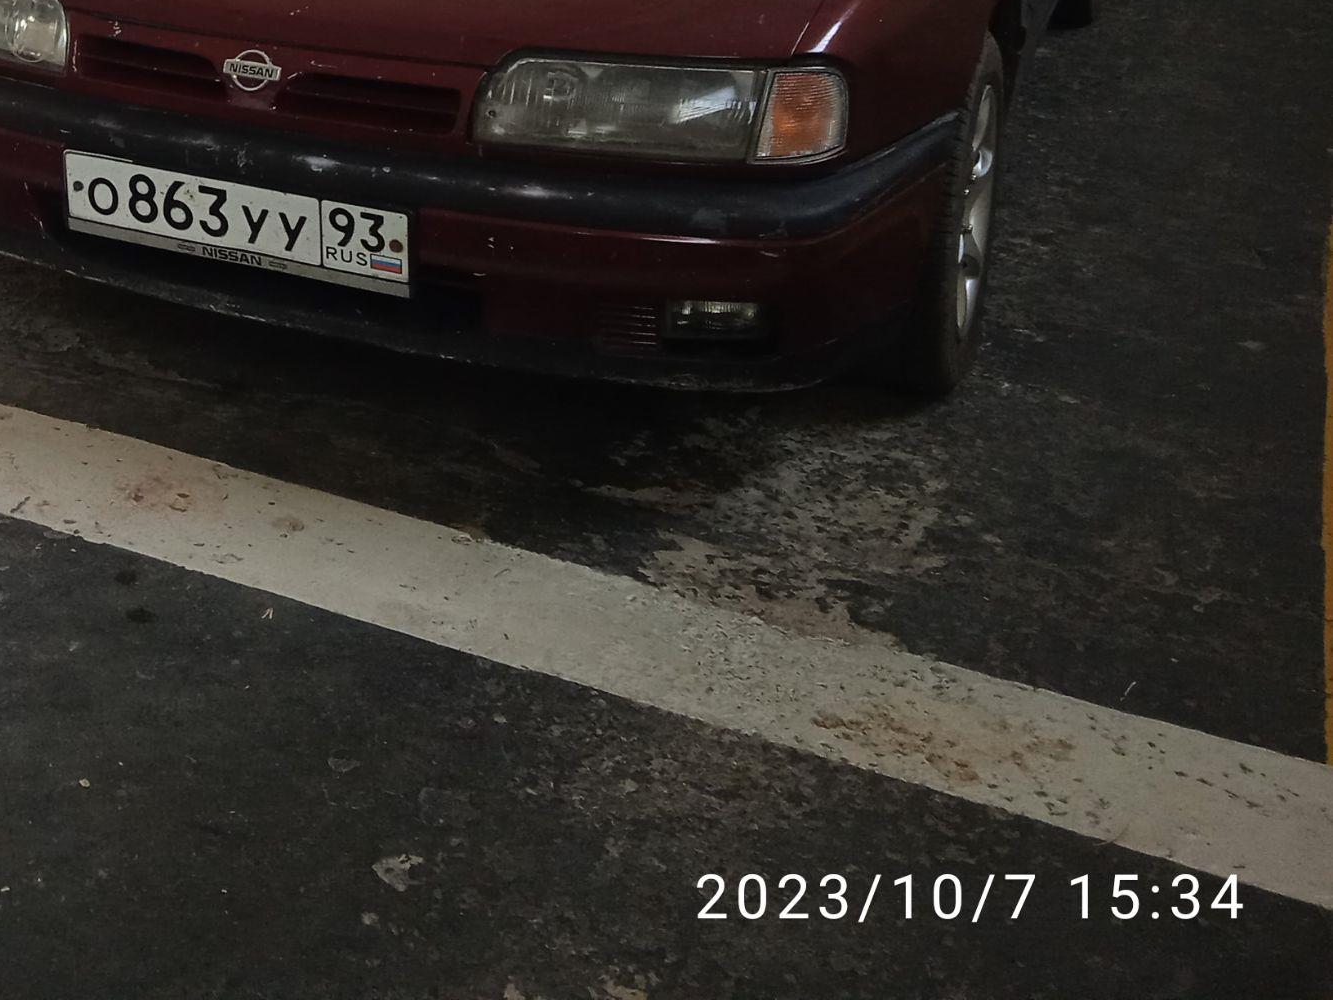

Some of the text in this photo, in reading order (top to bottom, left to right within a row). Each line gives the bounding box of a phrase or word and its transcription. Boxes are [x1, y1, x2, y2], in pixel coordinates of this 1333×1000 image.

[229, 63, 274, 79] NISSAN
[328, 207, 385, 253] 93
[201, 246, 263, 267] NISSAN
[325, 246, 368, 267] RUS
